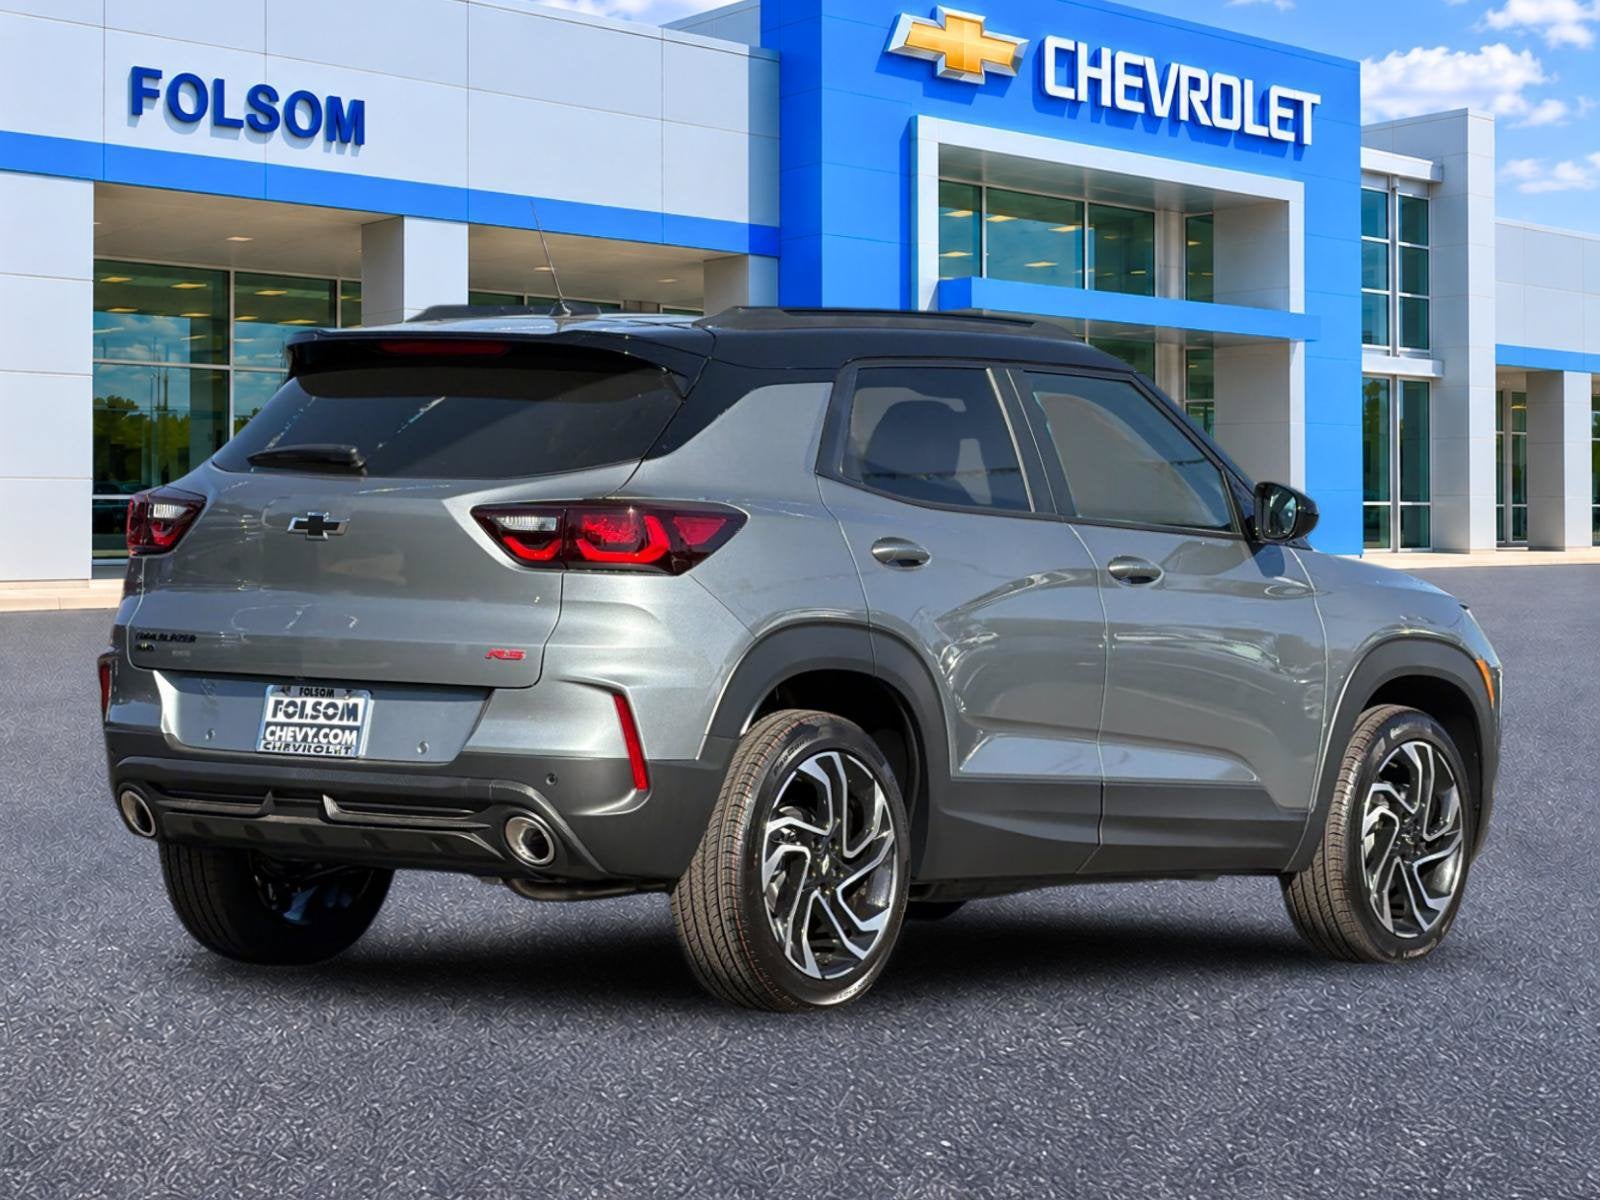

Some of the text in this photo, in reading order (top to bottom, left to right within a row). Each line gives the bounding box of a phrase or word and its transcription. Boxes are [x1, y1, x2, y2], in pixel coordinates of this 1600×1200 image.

[1044, 35, 1321, 145] CHEVROLET
[131, 66, 365, 145] FOLSOM
[299, 687, 335, 698] FOLSOM
[271, 699, 359, 722] FOLSOM
[265, 725, 358, 746] CHEVY.COM
